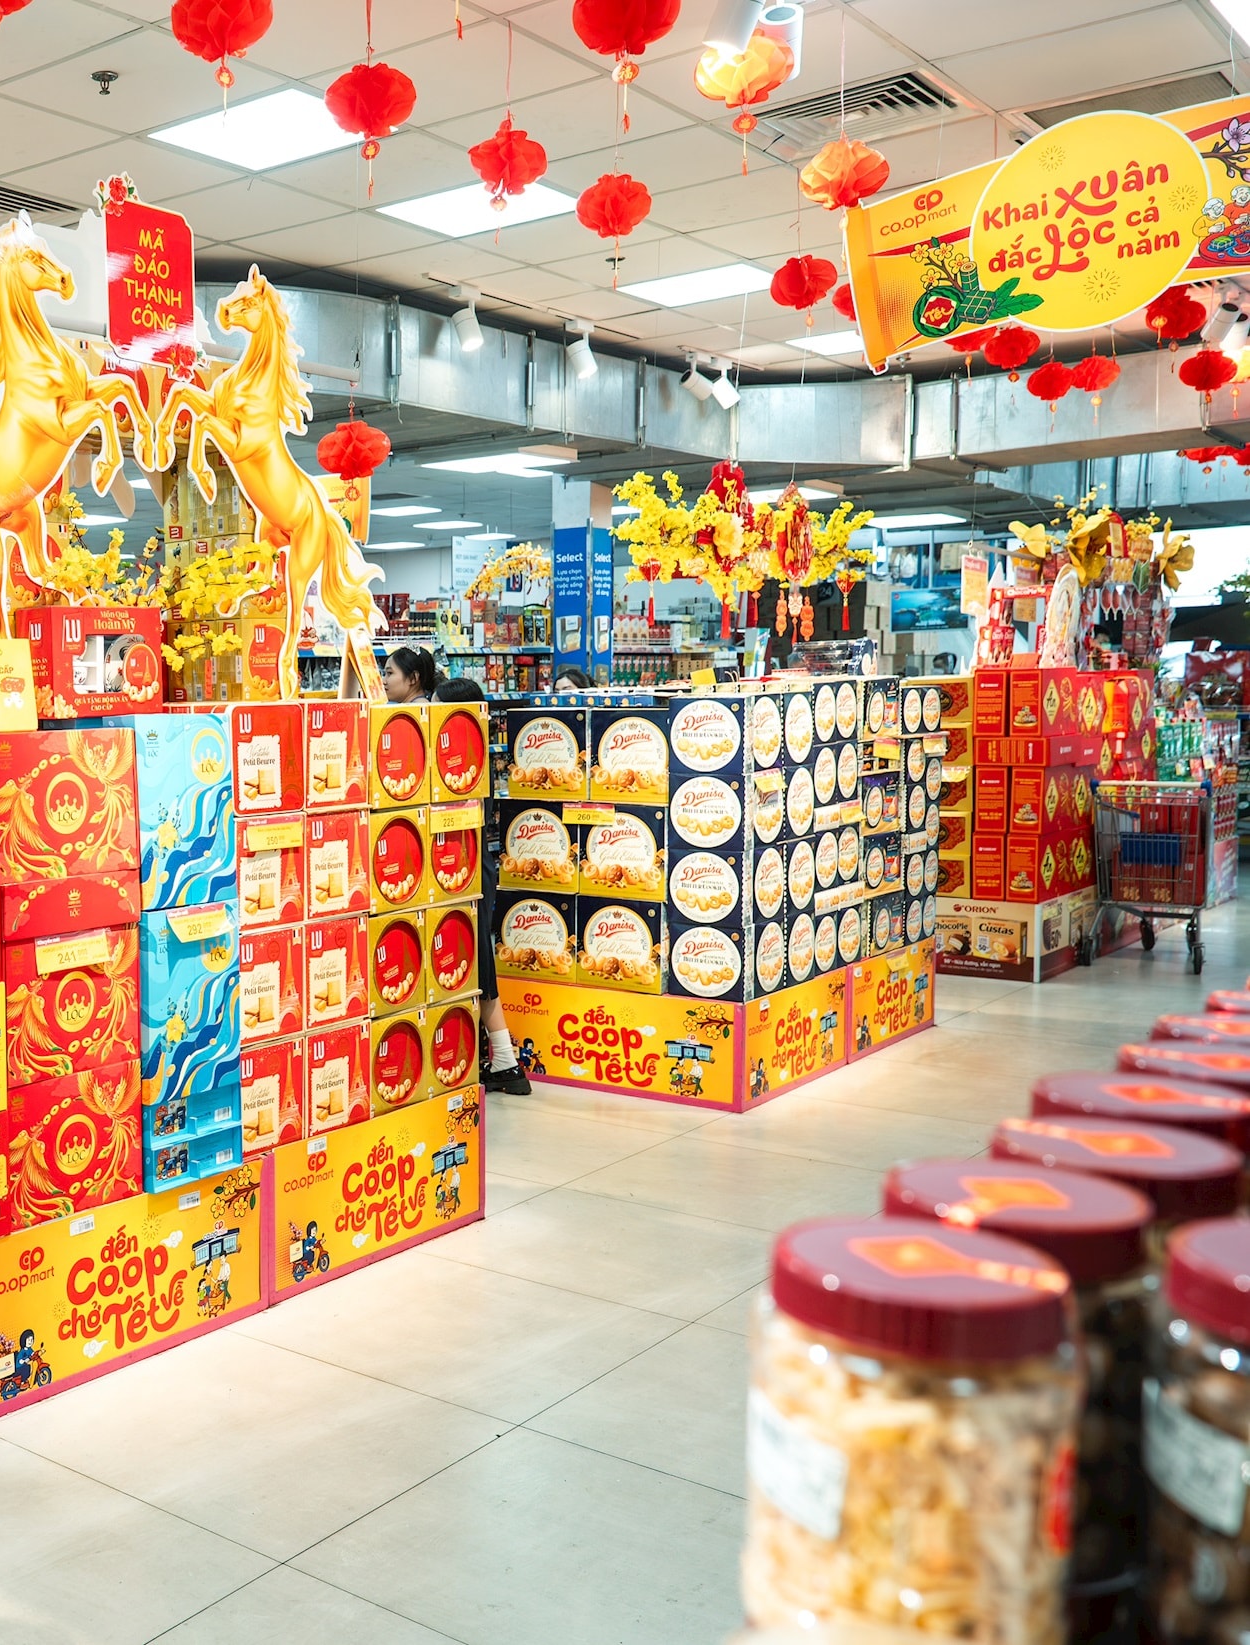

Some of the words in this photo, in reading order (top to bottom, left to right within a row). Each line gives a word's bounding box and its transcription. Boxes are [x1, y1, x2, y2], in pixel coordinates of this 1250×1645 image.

[983, 193, 1048, 232] Khai
[139, 227, 165, 251] MÃ
[988, 234, 1042, 274] đắc
[1032, 217, 1116, 281] Lộc
[1126, 194, 1160, 226] cả
[1117, 228, 1180, 259] năm
[133, 252, 170, 279] ĐÁO
[123, 277, 182, 308] THÀNH
[131, 303, 177, 331] CÔNG
[556, 553, 583, 563] Select
[594, 553, 612, 563] Select
[819, 585, 832, 597] 24
[30, 623, 42, 640] LU
[94, 618, 121, 630] Hoàn
[122, 618, 136, 632] Mỹ
[312, 711, 323, 729] LU
[382, 734, 391, 749] LU
[525, 729, 563, 749] Danisa
[243, 758, 256, 766] Petit
[256, 757, 276, 765] Beurre
[577, 813, 591, 821] 260
[598, 825, 640, 845] Danisa
[680, 863, 724, 882] Danisa
[964, 905, 998, 914] ORION
[979, 923, 1014, 936] Custas
[311, 931, 323, 949] LU
[684, 940, 727, 956] Danisa
[58, 950, 78, 965] 241
[210, 948, 226, 962] LỘC
[66, 1005, 85, 1021] LỘC
[584, 1005, 615, 1026] đến
[435, 1028, 444, 1044] LU
[585, 1050, 653, 1087] Tết
[639, 1053, 660, 1076] về
[316, 1083, 328, 1092] Petit
[327, 1079, 345, 1090] Beurre
[367, 1136, 393, 1168] đến
[367, 1193, 422, 1242] Tết
[410, 1175, 428, 1211] về
[100, 1225, 138, 1263] đến
[102, 1291, 179, 1350] Tết
[161, 1269, 188, 1310] về
